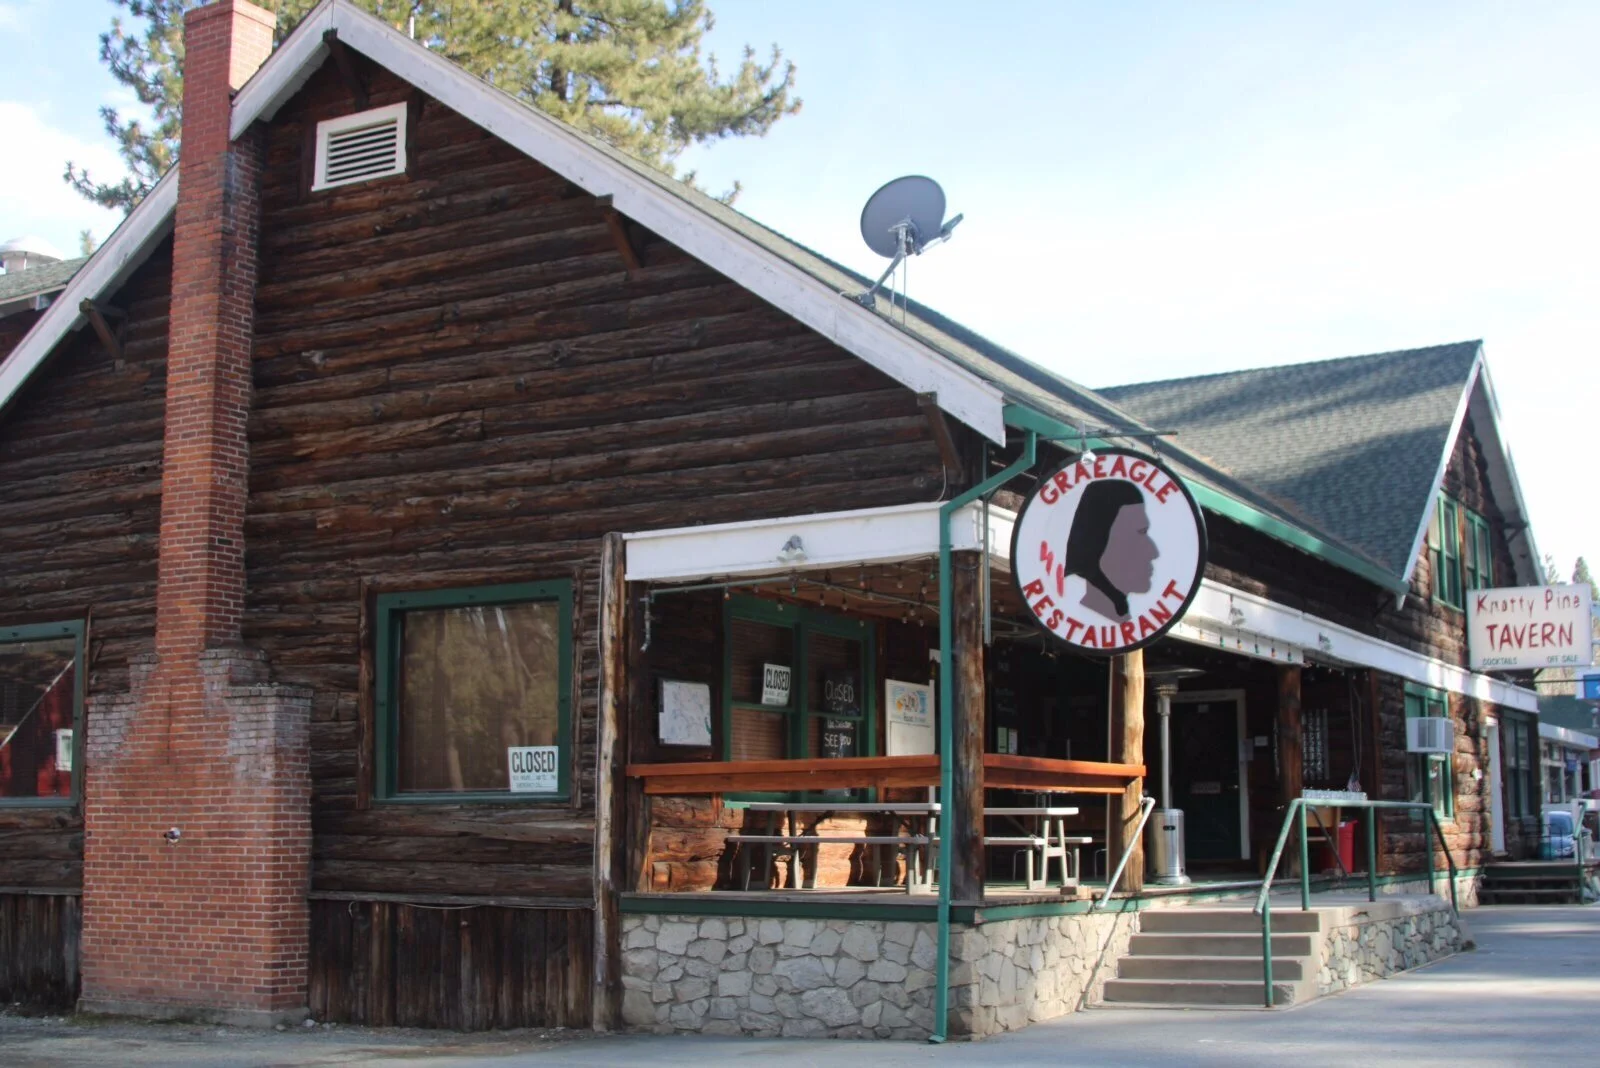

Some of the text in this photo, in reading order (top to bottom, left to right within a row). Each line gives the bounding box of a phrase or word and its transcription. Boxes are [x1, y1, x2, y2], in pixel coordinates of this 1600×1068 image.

[1040, 455, 1180, 505] GRAEAGLE
[1023, 579, 1186, 647] RESTAURANT
[1476, 588, 1580, 617] Knotty Pine
[1486, 621, 1573, 652] TAVERN
[766, 668, 790, 691] CLOSED
[512, 751, 555, 773] CLOSED
